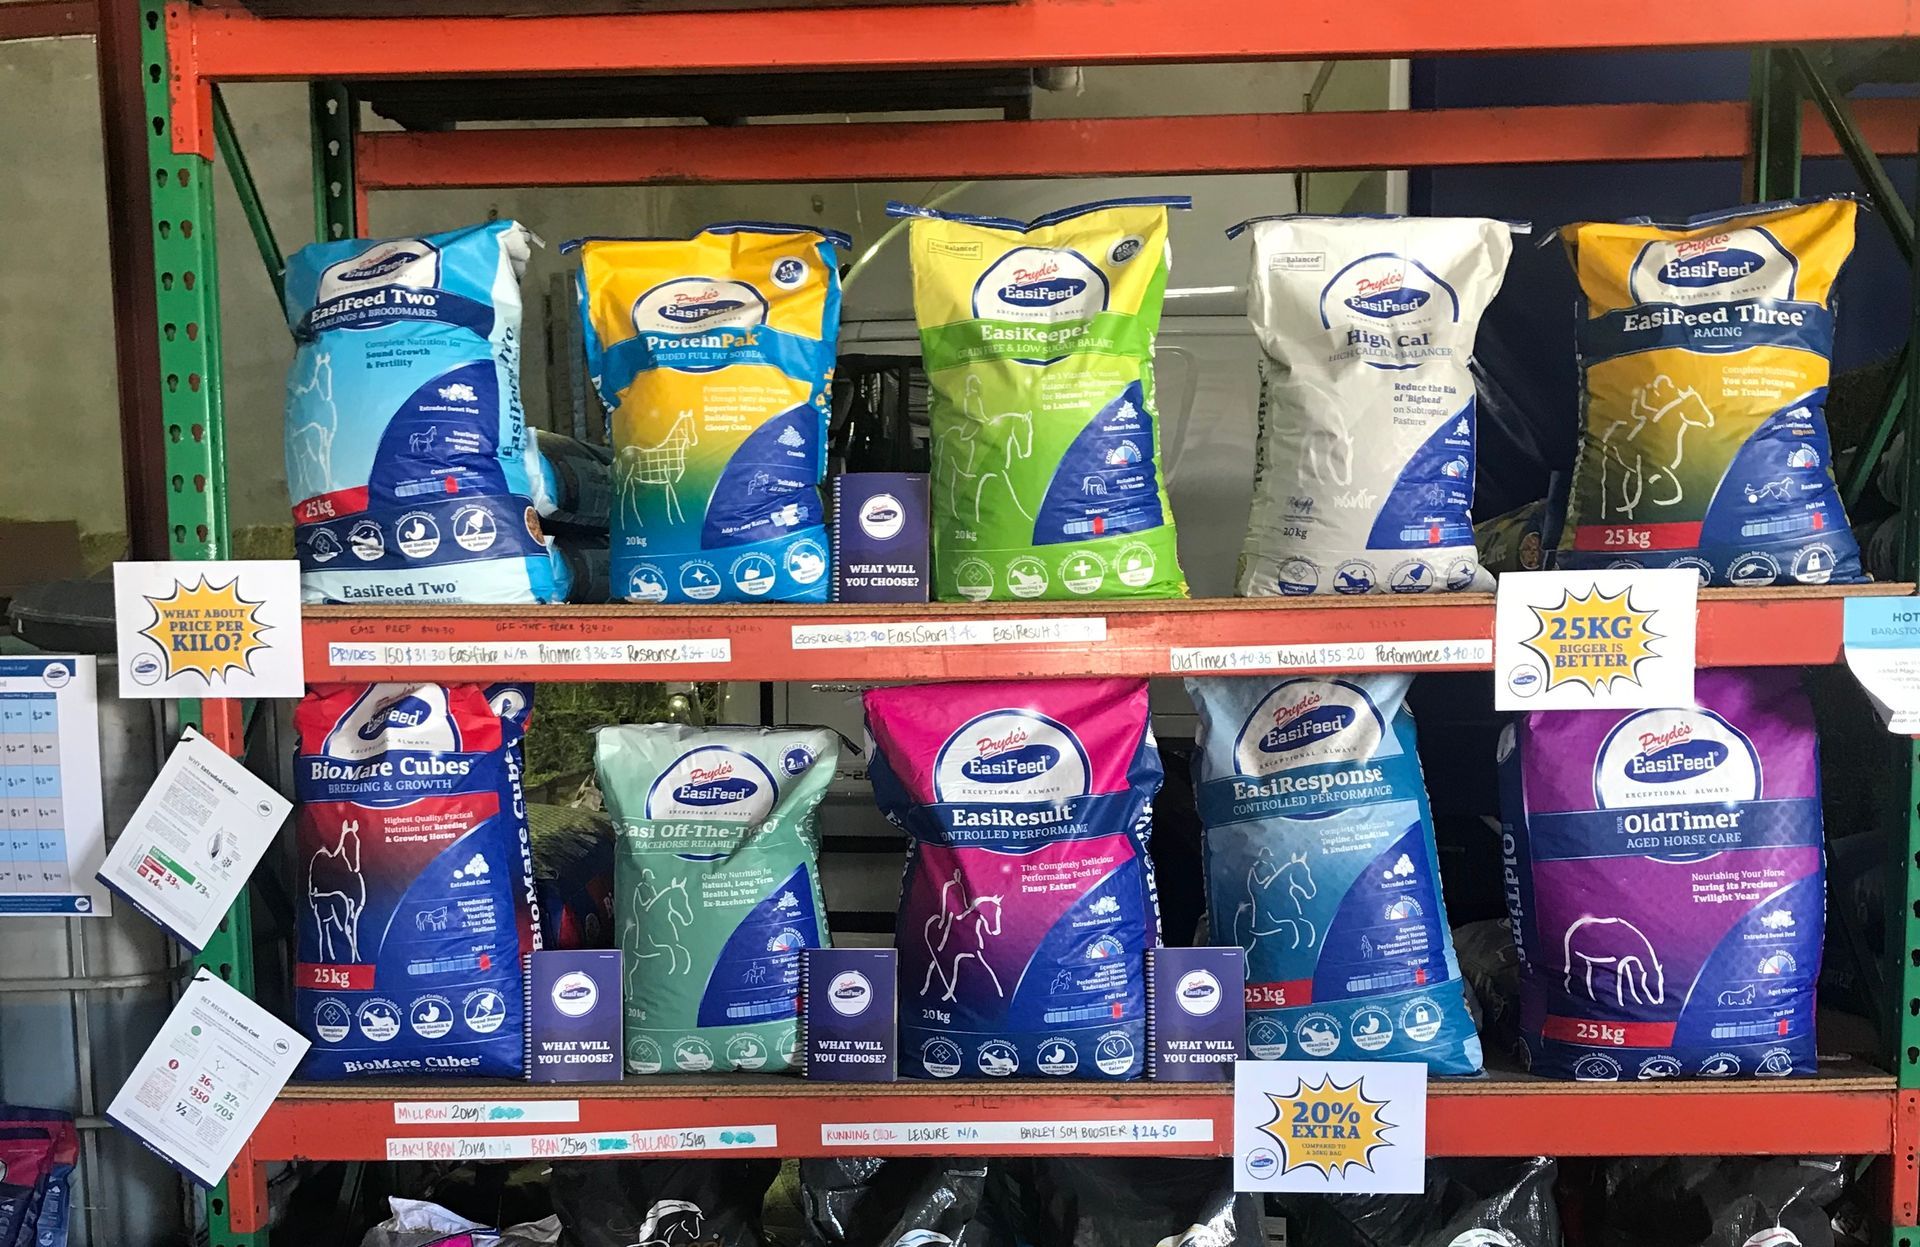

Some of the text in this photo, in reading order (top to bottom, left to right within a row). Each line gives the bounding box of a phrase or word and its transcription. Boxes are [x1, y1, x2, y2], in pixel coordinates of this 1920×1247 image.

[1013, 260, 1059, 283] Pryde's
[1667, 261, 1750, 279] EasiFeed
[1355, 271, 1403, 292] Pryde's
[673, 288, 720, 304] Pryde's
[1004, 285, 1075, 300] EasiFeed
[311, 289, 436, 323] EasiFeed Two
[1351, 296, 1419, 313] EasiFeed
[1624, 305, 1803, 332] EasiFeed Three
[981, 323, 1090, 343] EasiKeeper
[1347, 329, 1430, 349] High Cal
[1694, 327, 1742, 338] RACING
[646, 332, 759, 351] ProteinPak
[366, 347, 430, 359] Sound Growth
[367, 358, 412, 369] & Fertility
[1395, 383, 1425, 392] Reduce
[1428, 385, 1441, 393] the
[1406, 406, 1448, 418] Subtropical
[1393, 417, 1426, 426] Pastures
[850, 565, 915, 573] WHAT WILL
[845, 577, 919, 586] YOU CHOOSE?
[344, 582, 456, 598] EasiFeed Two
[164, 609, 245, 618] WHAT ABOUT
[170, 621, 244, 631] PRICE PER
[1550, 616, 1633, 640] 25KG
[172, 633, 242, 651] KILO?
[1559, 644, 1623, 654] BIGGER IS
[331, 647, 376, 661] PRYDES
[627, 644, 681, 662] Response
[1555, 654, 1628, 668] BETTER
[1273, 693, 1322, 725] Pryde's
[1266, 717, 1343, 747] EasiFeed
[1639, 723, 1693, 750] Pryde's
[976, 729, 1028, 755] Pryde's
[311, 757, 469, 781] BioMare Cubes
[970, 757, 1047, 775] EasiFeed
[1633, 753, 1715, 774] EasiFeed
[690, 762, 734, 783] Pryde's
[328, 780, 452, 794] BREEDING & GROWTH
[1233, 767, 1382, 800] EasiResponse
[679, 787, 746, 800] EasiFeed
[1233, 785, 1392, 815] CONTROLLED PERFORMANCE
[1626, 790, 1687, 798] EXCEPTIONAL
[384, 811, 473, 826] Highest Quality, Practical
[952, 804, 1073, 826] EasiResult
[1624, 813, 1740, 833] OldTimer
[385, 824, 419, 834] Nutrition
[434, 821, 467, 832] Breeding
[394, 833, 428, 844] Growing
[430, 832, 455, 840] Horses
[1627, 833, 1742, 849] AGED HORSE CARE
[1022, 855, 1114, 872] The Completely Delicious
[701, 871, 727, 881] Quality
[729, 869, 761, 878] Nutrition
[702, 876, 774, 890] Natural, Long-Term
[1022, 871, 1071, 882] Performance
[1073, 870, 1090, 879] Feed
[1692, 869, 1785, 882] Nourishing Your Horse
[196, 881, 210, 899] 73%
[1022, 882, 1076, 893] Fussy Eaters
[1692, 883, 1725, 892] During
[1741, 881, 1778, 890] Precious
[457, 898, 493, 907] Broodmares
[703, 898, 755, 907] Ex-Racehorse
[1692, 892, 1760, 903] Twilight Years
[542, 1041, 610, 1051] WHAT WILL
[818, 1041, 883, 1050] WHAT WILL
[1167, 1041, 1234, 1050] WHAT WILL
[344, 1059, 419, 1073] BioMare
[426, 1056, 479, 1069] Cubes
[538, 1054, 614, 1064] YOU CHOOSE?
[814, 1054, 887, 1063] YOU CHOOSE?
[1163, 1054, 1238, 1063] YOU CHOOSE?
[198, 1073, 215, 1091] 36%
[189, 1085, 210, 1104] $350
[224, 1091, 240, 1108] 37%
[213, 1102, 233, 1121] $705
[451, 1104, 480, 1121] 20kg
[1292, 1102, 1361, 1124] 20%
[908, 1128, 950, 1141] LEISURE
[958, 1129, 979, 1139] N/A
[1021, 1127, 1055, 1139] BARLEY
[1082, 1126, 1127, 1138] BOOSTER
[1292, 1124, 1361, 1140] EXTRA
[531, 1138, 559, 1154] BRAN
[560, 1137, 588, 1154] 25kg
[679, 1132, 706, 1148] 25kg
